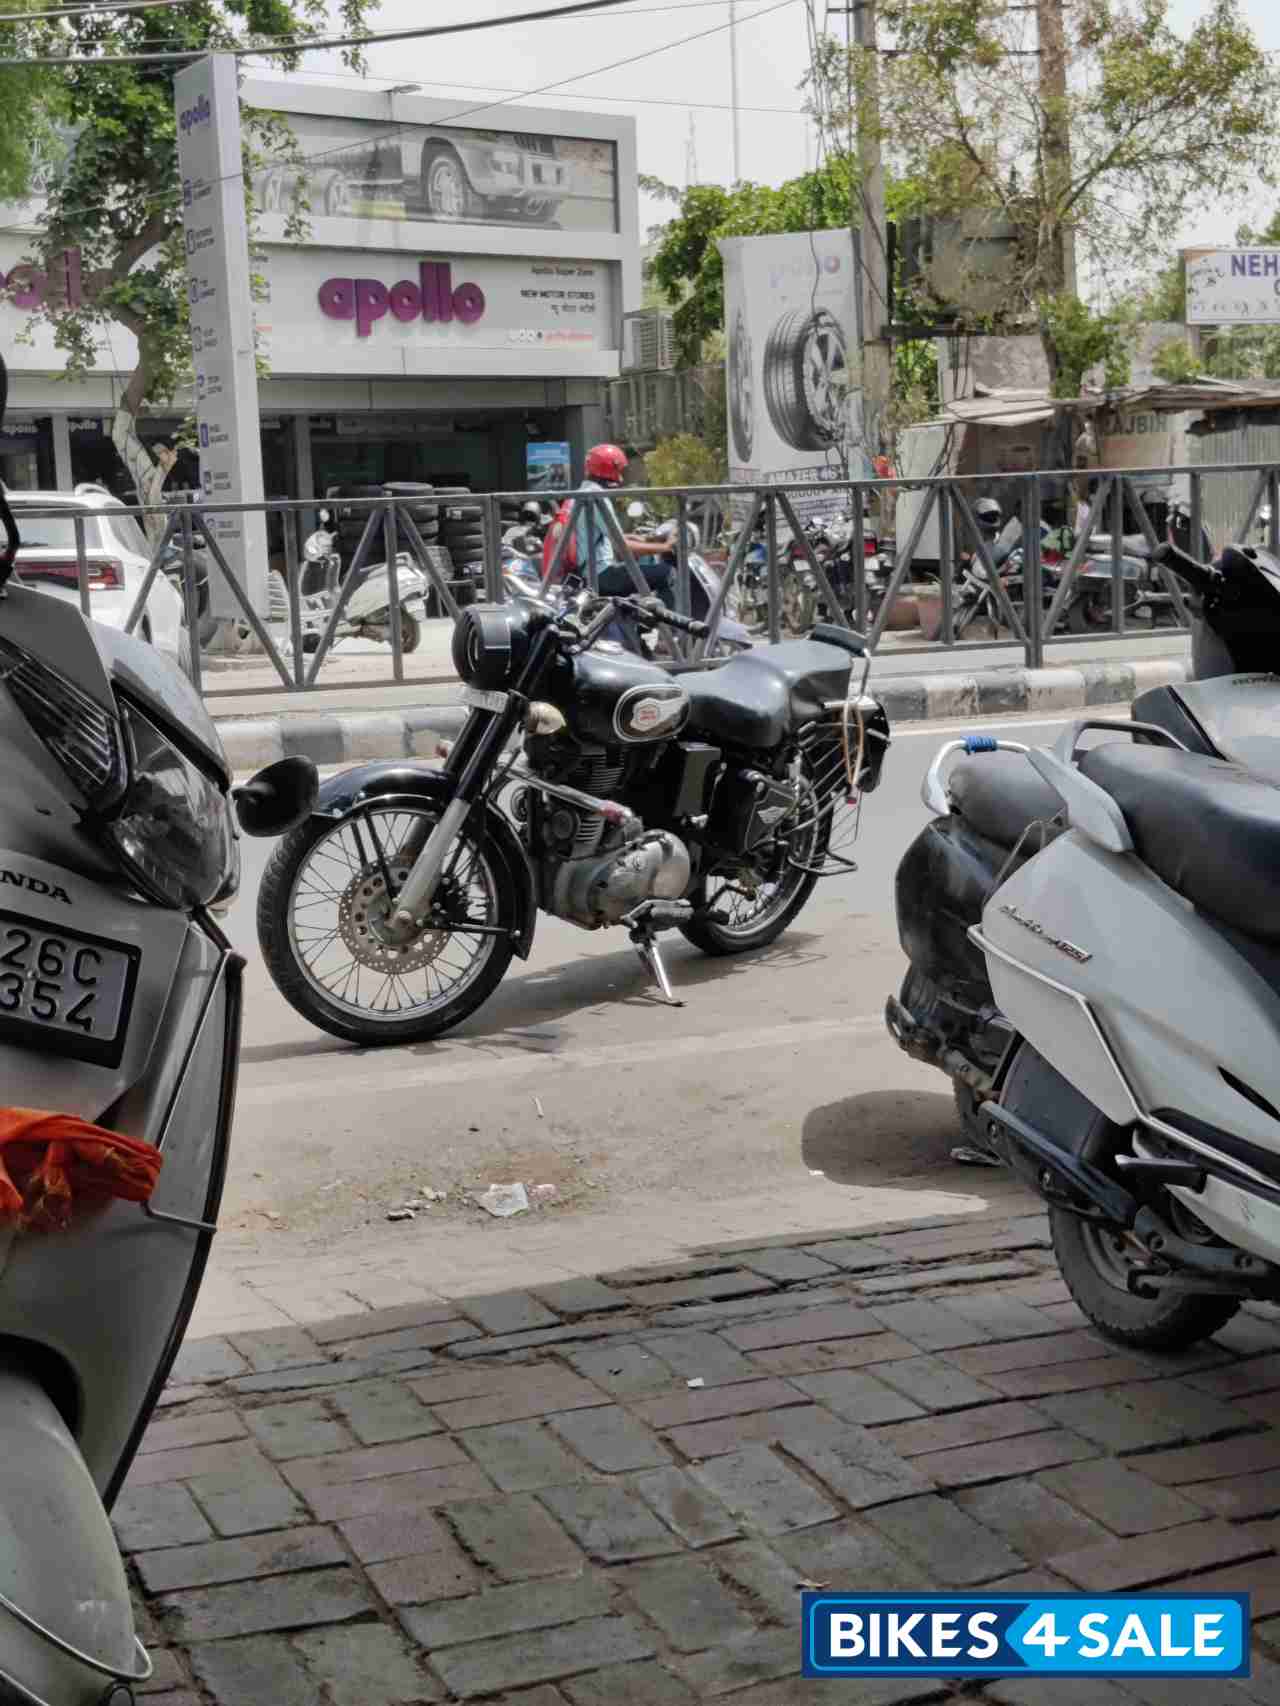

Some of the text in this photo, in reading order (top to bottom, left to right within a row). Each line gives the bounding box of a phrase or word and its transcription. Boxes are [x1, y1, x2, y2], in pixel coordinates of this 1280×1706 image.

[1231, 254, 1278, 277] NEH
[318, 261, 486, 338] apollo
[0, 928, 102, 985] 26C
[0, 972, 96, 1032] 354
